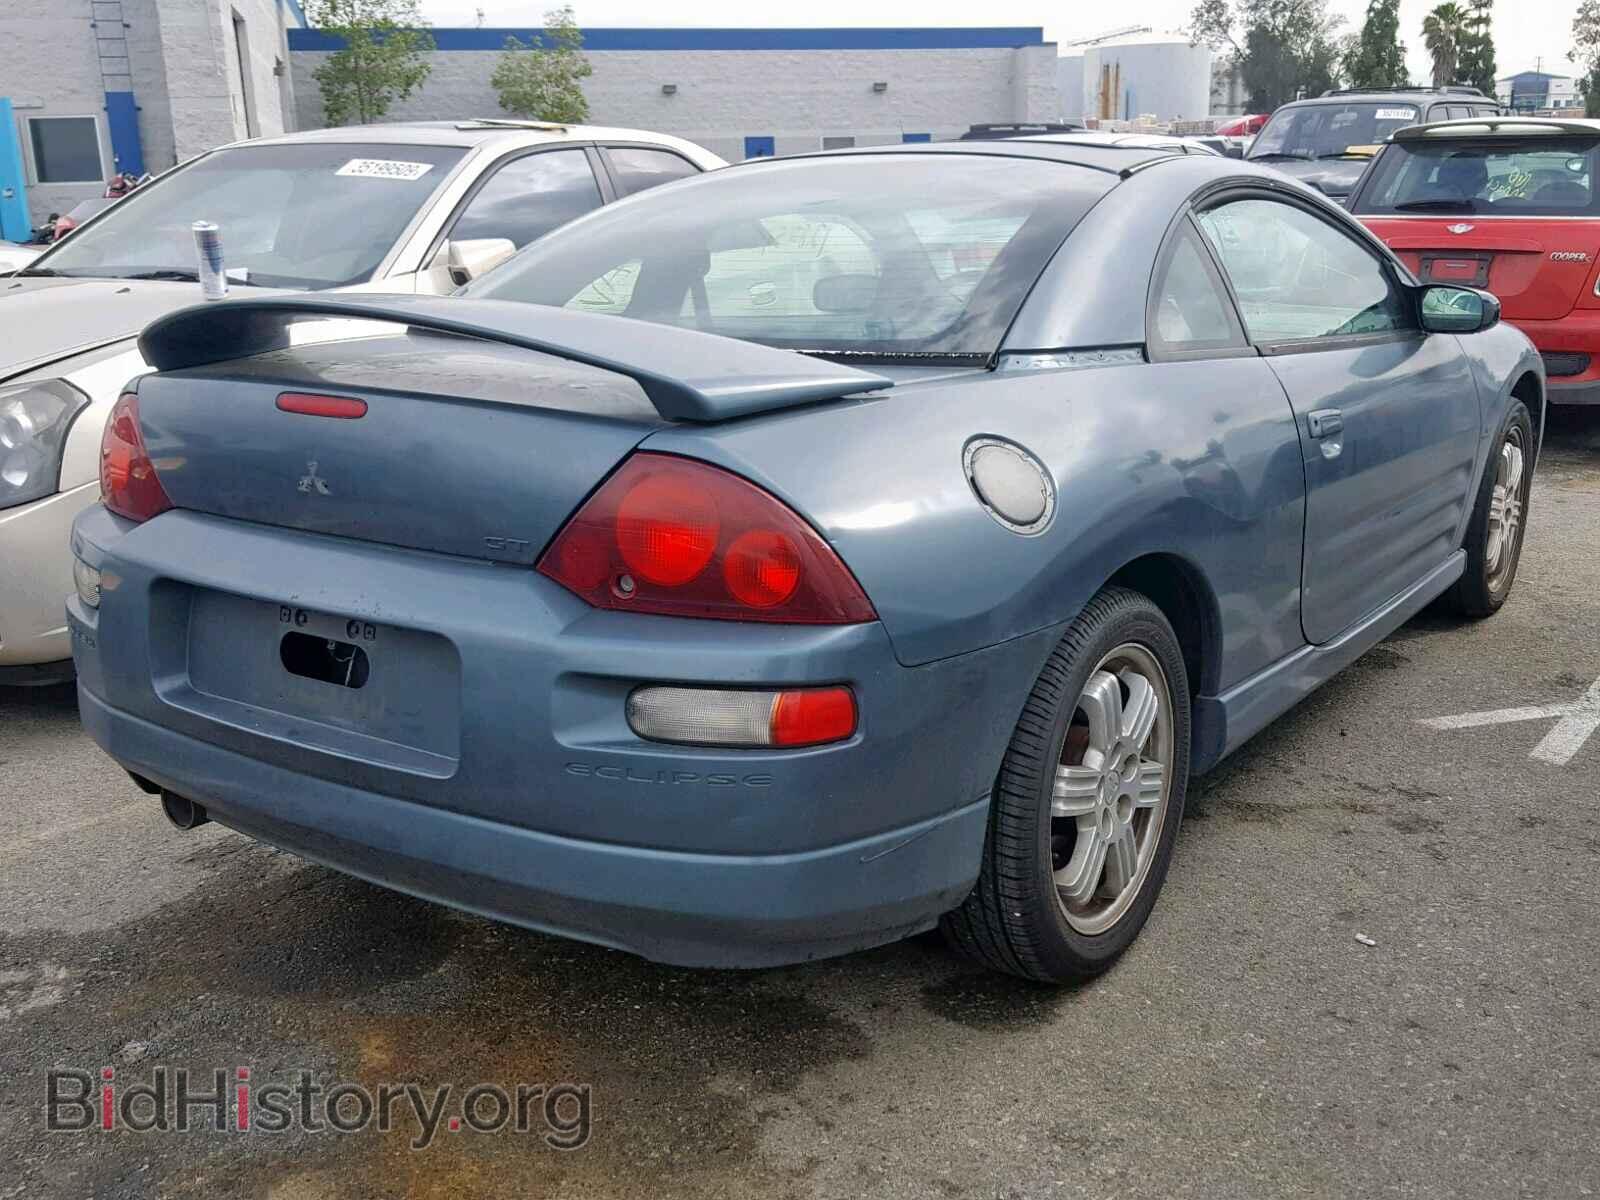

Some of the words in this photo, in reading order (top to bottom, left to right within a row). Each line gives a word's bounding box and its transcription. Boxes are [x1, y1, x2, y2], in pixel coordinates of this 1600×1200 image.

[1550, 251, 1586, 262] COOPER
[482, 536, 529, 553] GT
[564, 762, 775, 788] ECLIPSE
